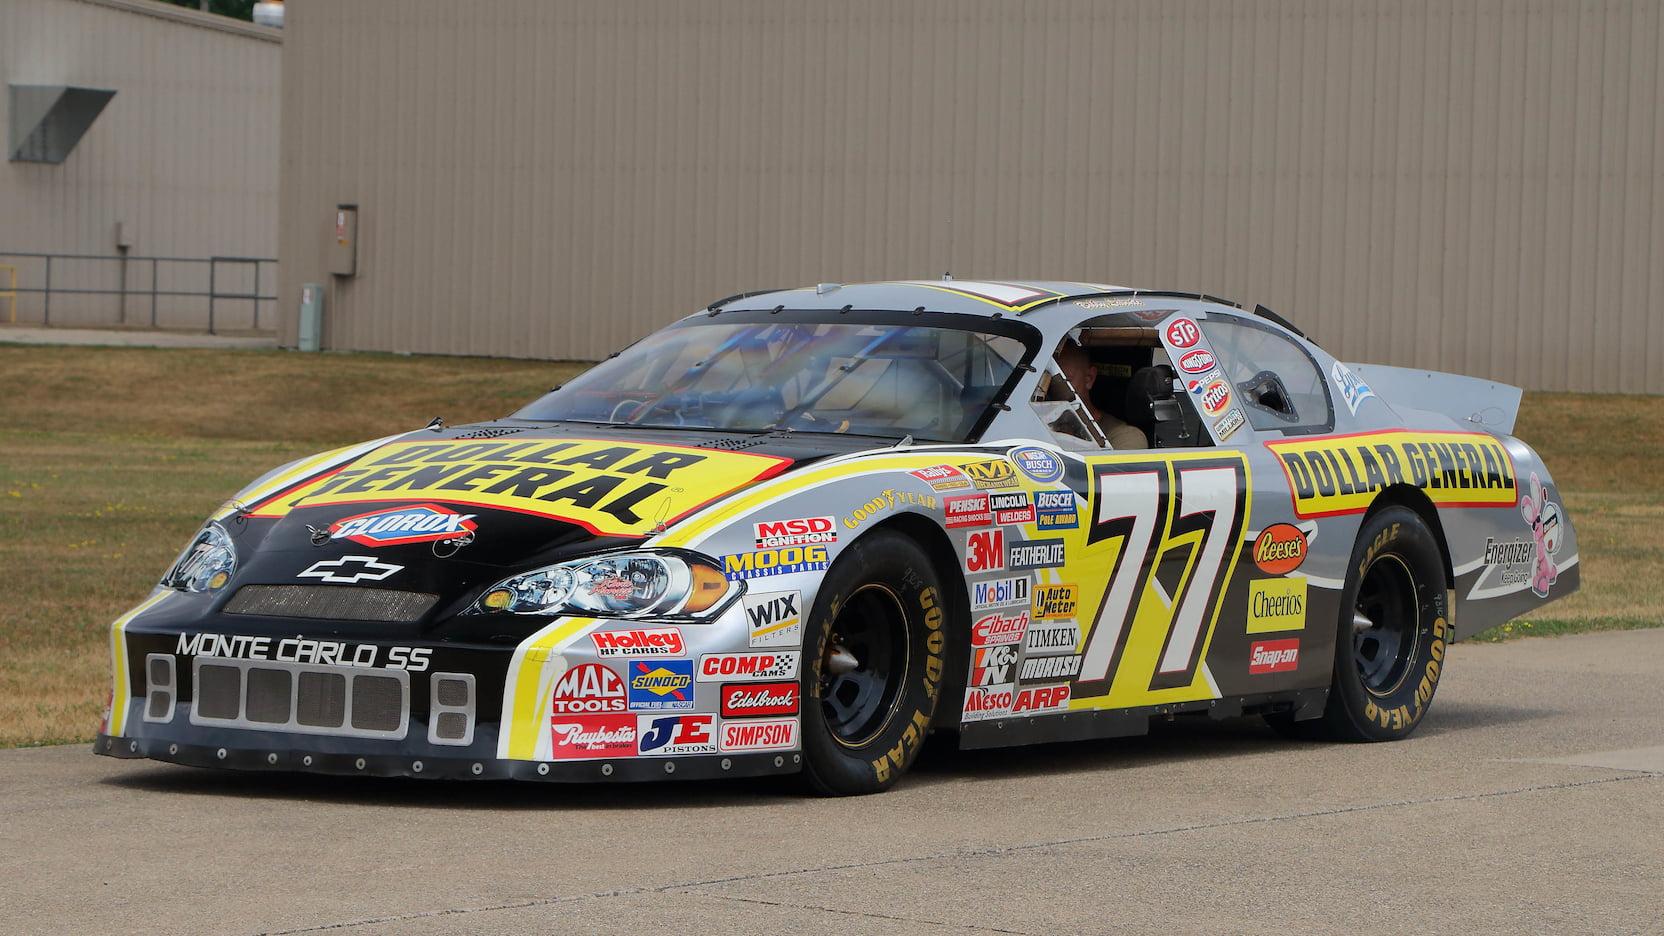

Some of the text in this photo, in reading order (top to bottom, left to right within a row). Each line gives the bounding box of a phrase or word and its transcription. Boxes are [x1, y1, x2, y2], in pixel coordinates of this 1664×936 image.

[1171, 321, 1197, 346] STP
[1199, 369, 1221, 387] PEPSI
[363, 443, 707, 479] DOLLAR
[1026, 460, 1053, 469] BUSCH
[1281, 443, 1514, 499] DOLLAR GENERAL
[288, 460, 668, 525] GENERAL
[991, 495, 1027, 508] LINCOLN
[1038, 493, 1073, 508] BUSCH
[949, 498, 986, 513] PENSKE
[1000, 511, 1031, 523] WELDERS
[331, 514, 478, 539] CLOROX
[759, 518, 832, 538] MSD
[1040, 514, 1054, 525] POLE
[762, 532, 832, 548] IGNITION
[967, 530, 1003, 571] 3M
[1257, 531, 1303, 562] Reese's
[1358, 523, 1400, 579] EAGLE
[725, 545, 827, 574] MOOG
[1010, 544, 1064, 567] FEATHERLITE
[1484, 537, 1533, 569] Energizer
[731, 561, 828, 580] CHASSIS PARTS
[1074, 461, 1242, 690] 77
[976, 580, 1012, 605] Mobil
[1046, 588, 1071, 601] Auto
[1253, 588, 1302, 618] Cheerios
[747, 593, 799, 628] WIX
[1045, 601, 1076, 614] Meter
[752, 625, 799, 645] FILTERS
[971, 612, 1029, 646] Eibach
[1028, 627, 1077, 648] TIMKEN
[175, 632, 433, 671] MONTE CARLO SS
[593, 631, 682, 653] Holley
[601, 645, 669, 656] HP CARBS
[703, 656, 775, 676] COMP
[1251, 646, 1298, 669] Snap-on
[556, 664, 626, 699] MAC
[635, 676, 689, 688] SUNOCO
[752, 669, 787, 678] CAMS
[555, 699, 626, 712] TOOLS
[728, 689, 794, 710] Edelbrock
[1012, 686, 1070, 712] ARP
[552, 723, 636, 746] Raybestos
[640, 715, 712, 752] JE
[725, 722, 793, 748] SIMPSON
[664, 744, 717, 755] PISTONS
